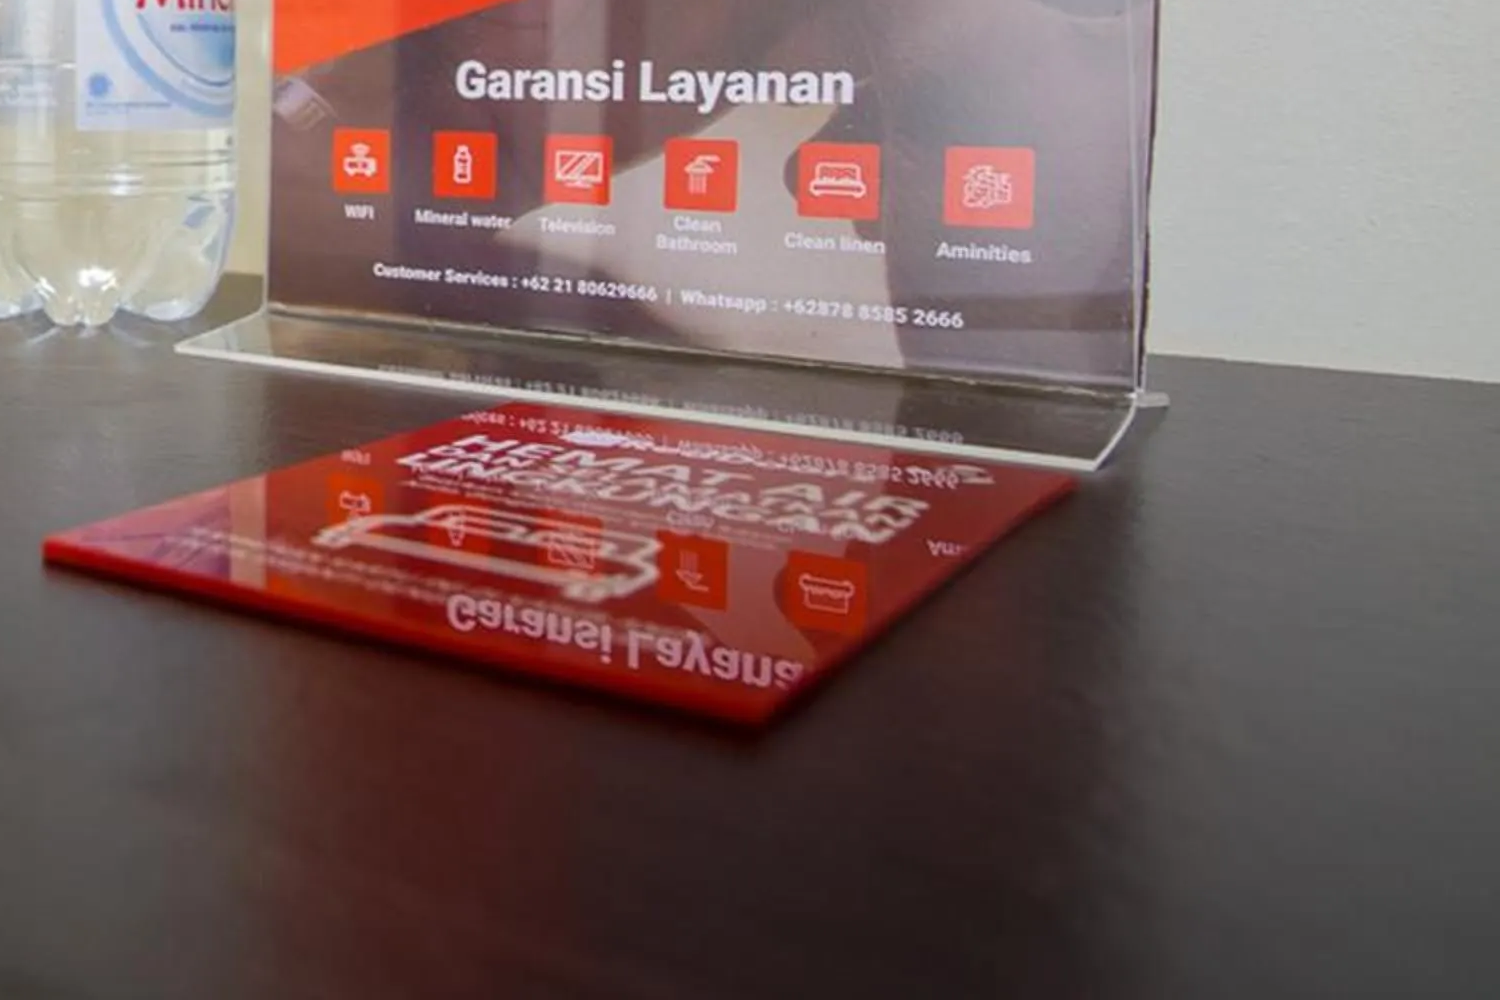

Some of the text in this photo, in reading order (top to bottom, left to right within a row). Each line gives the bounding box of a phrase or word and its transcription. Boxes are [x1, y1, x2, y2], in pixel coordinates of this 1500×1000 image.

[455, 59, 854, 113] Garansi Layanan
[414, 208, 511, 230] Mineral water
[540, 217, 616, 237] Television
[673, 214, 721, 233] Clean
[655, 233, 738, 255] Bathroom
[784, 231, 886, 255] Clean linen
[935, 241, 1032, 265] Aminities
[373, 262, 442, 284] Customer
[445, 268, 508, 289] Services
[521, 275, 550, 293] +62
[554, 278, 572, 294] 21
[577, 279, 658, 302] 80629666
[679, 288, 767, 314] Whatsapp
[783, 299, 854, 319] +62878
[858, 305, 907, 324] 8585
[912, 308, 965, 330] 2666
[450, 434, 755, 486] HEMAT
[758, 483, 931, 518] AIR
[396, 452, 898, 545] LINGKUNGAN
